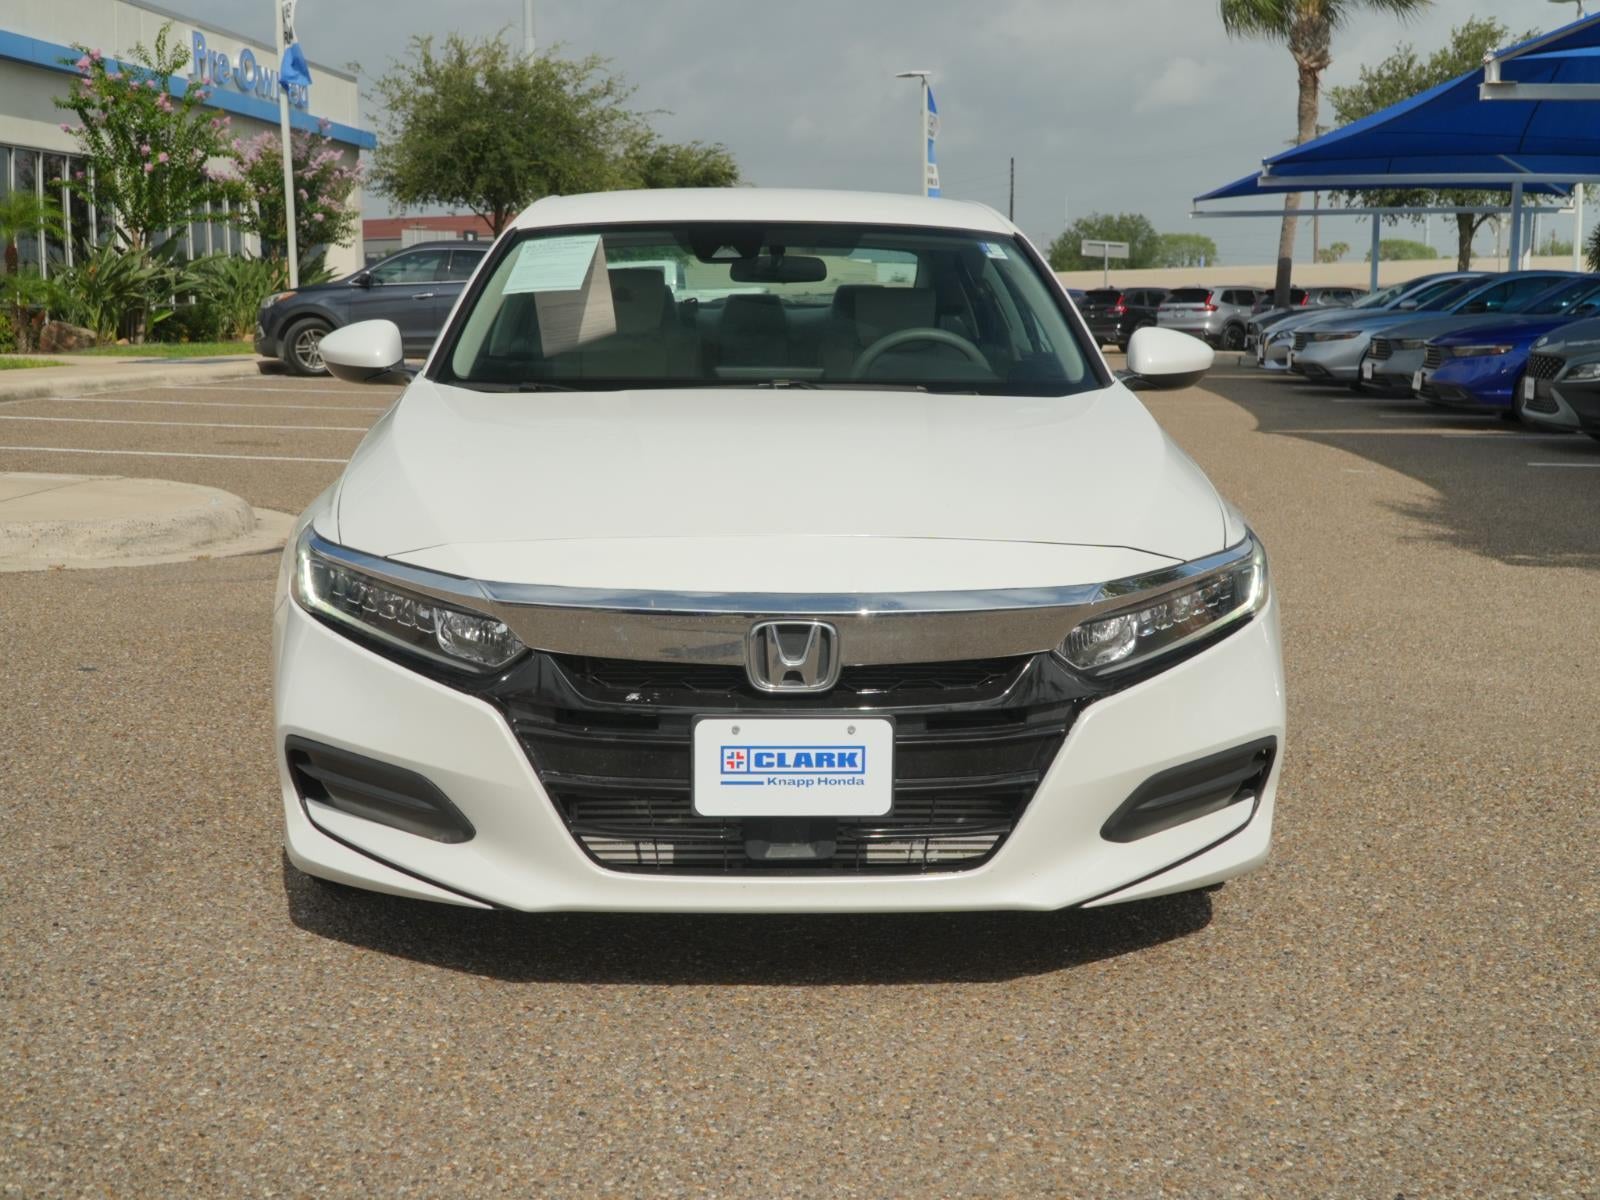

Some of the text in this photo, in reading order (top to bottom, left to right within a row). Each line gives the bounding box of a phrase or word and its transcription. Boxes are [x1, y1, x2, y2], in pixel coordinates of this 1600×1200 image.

[754, 752, 858, 768] CLARK
[767, 777, 864, 787] Knapp Honda
